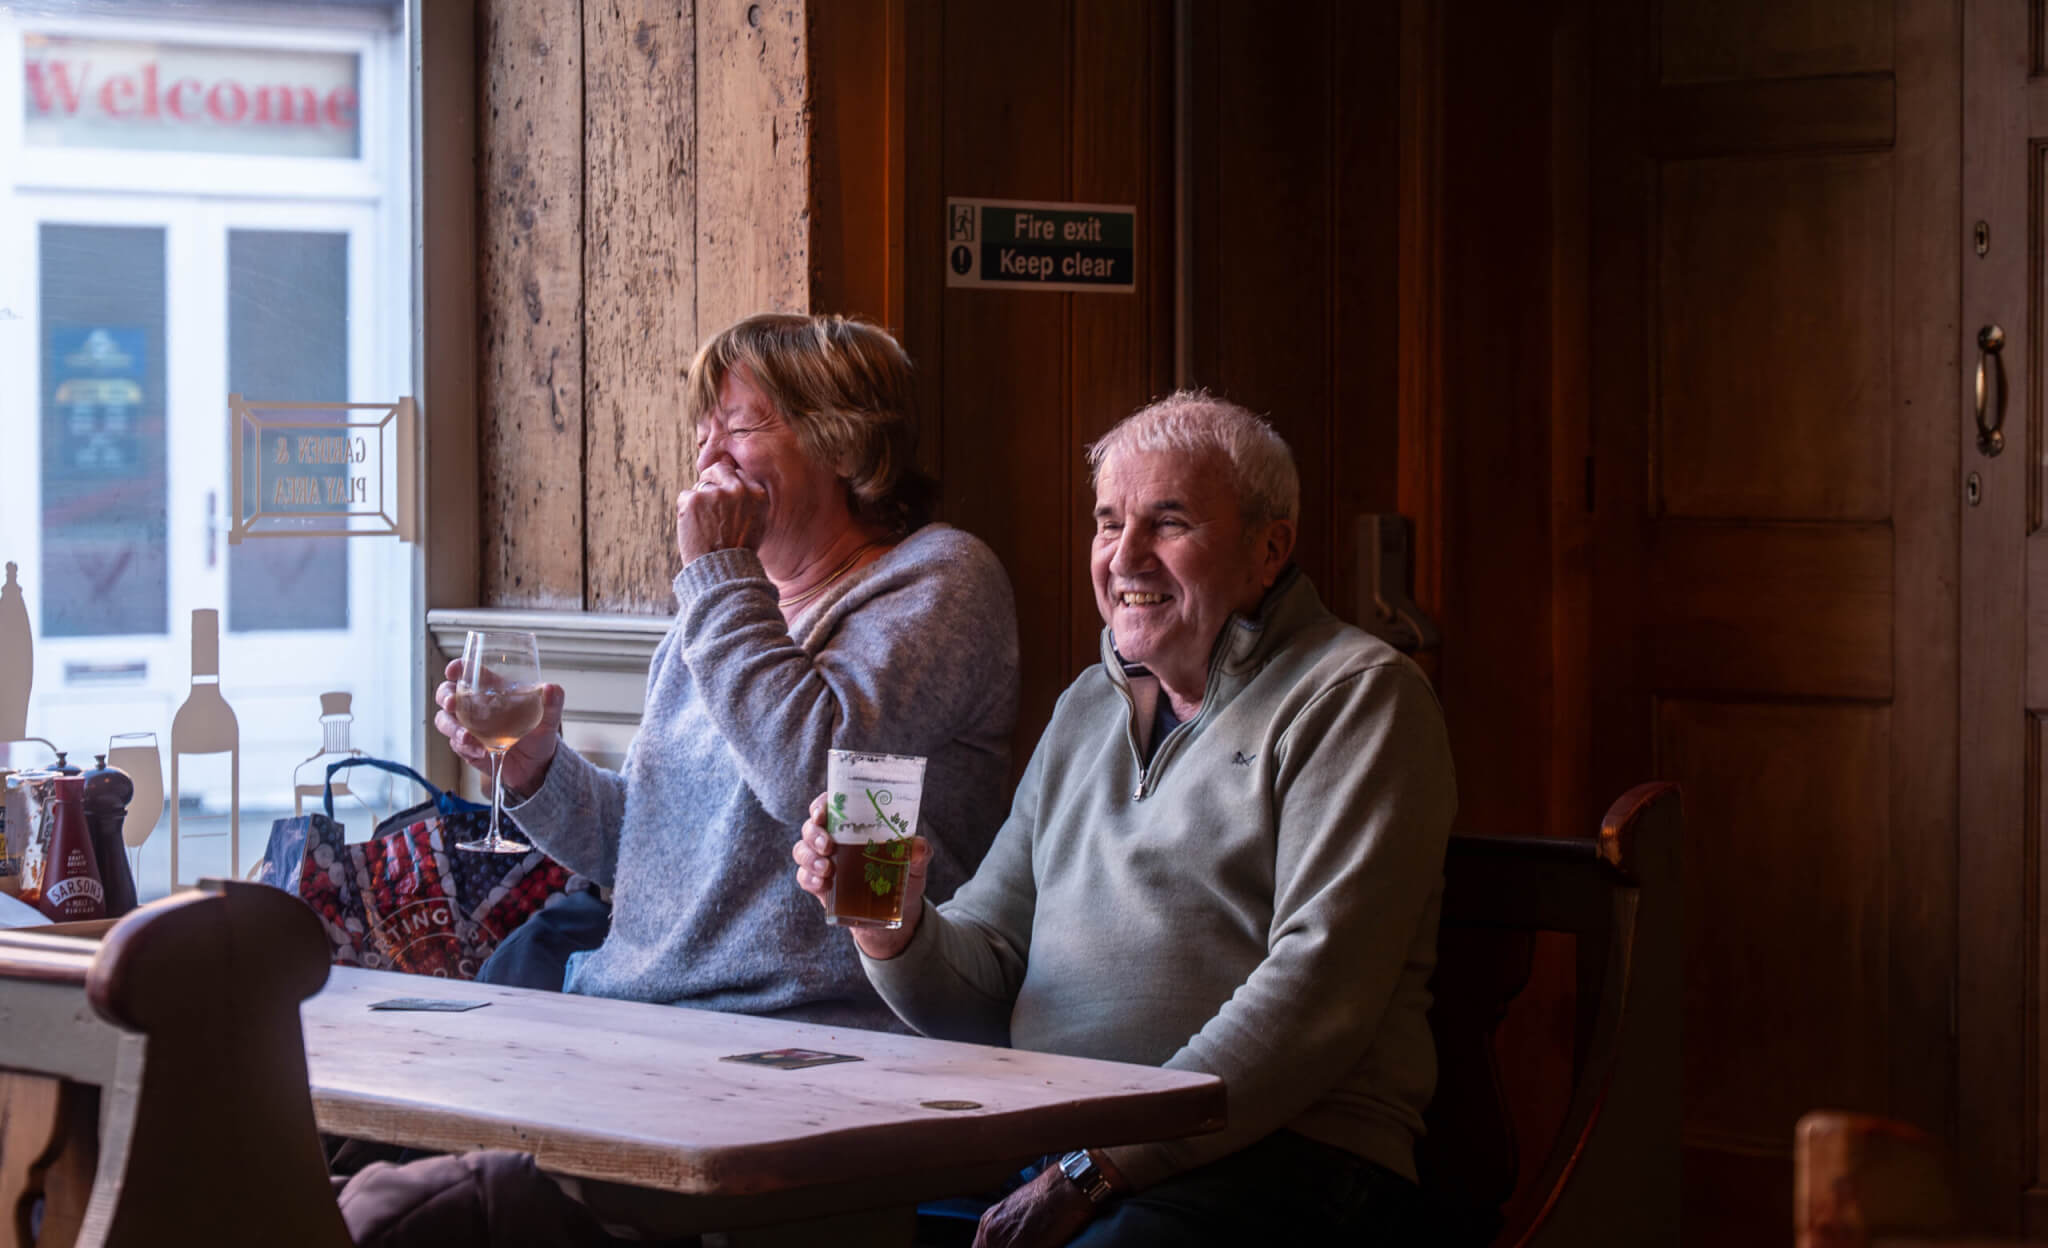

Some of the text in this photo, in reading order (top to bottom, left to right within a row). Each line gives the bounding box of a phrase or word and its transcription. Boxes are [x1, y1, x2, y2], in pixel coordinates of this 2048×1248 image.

[25, 59, 358, 129] Welcome
[1014, 213, 1103, 241] Fire exit
[1000, 249, 1116, 281] Keep clear
